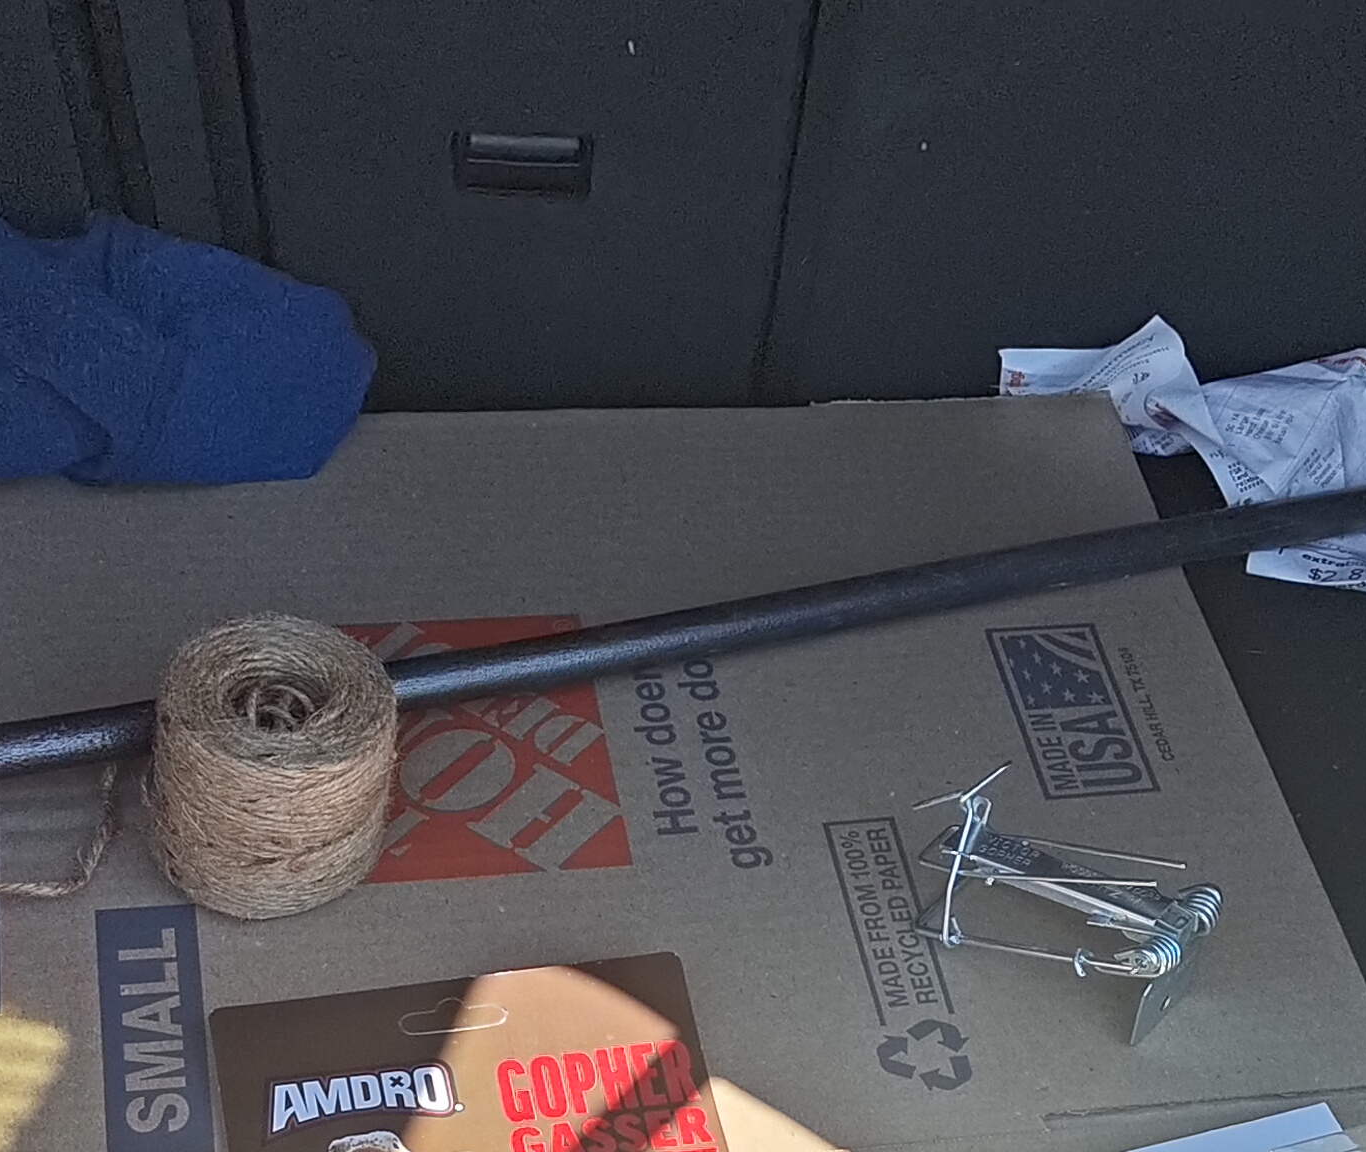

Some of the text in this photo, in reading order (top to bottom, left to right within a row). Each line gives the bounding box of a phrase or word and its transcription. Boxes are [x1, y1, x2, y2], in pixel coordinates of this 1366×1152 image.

[677, 657, 774, 870] get more do
[1028, 713, 1079, 791] MADE IN
[1059, 709, 1143, 788] USA
[1149, 722, 1175, 762] CEDAR
[652, 755, 700, 836] How
[839, 830, 911, 1009] MADE FROM 100%
[866, 827, 939, 1006] RECYCLED PAPER
[117, 927, 191, 1135] SMALL
[269, 1065, 452, 1135] AMDRO
[496, 1037, 704, 1125] GOPHER
